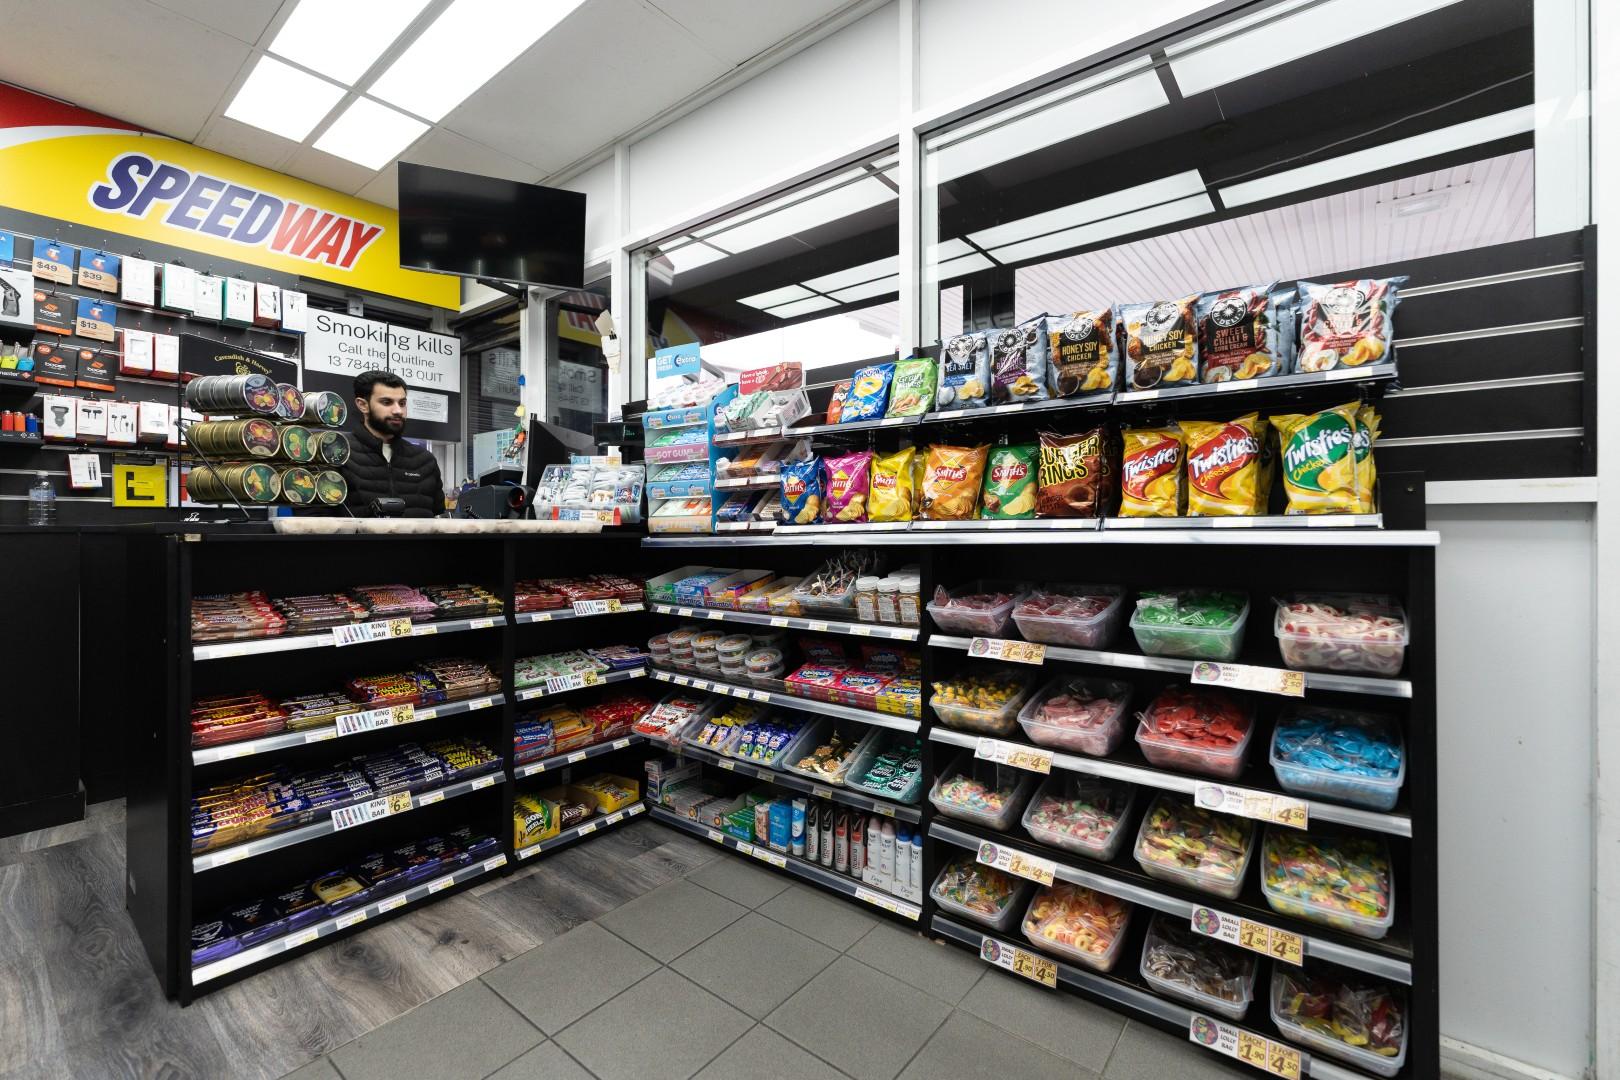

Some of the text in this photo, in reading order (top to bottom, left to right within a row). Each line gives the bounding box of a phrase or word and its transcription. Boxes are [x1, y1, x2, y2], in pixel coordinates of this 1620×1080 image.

[92, 154, 382, 269] SPEEDWAY
[36, 261, 58, 272] $49
[82, 270, 102, 281] $39
[80, 320, 97, 330] $13
[317, 315, 454, 356] Smoking kills
[1168, 329, 1184, 340] SOY
[1215, 326, 1245, 339] SWEET
[1149, 341, 1177, 352] CHICKEN
[1213, 333, 1240, 347] CHILLI
[338, 342, 435, 368] Call the Quitline
[1062, 341, 1098, 356] HONEY SOY
[214, 353, 245, 362] Cavendish
[657, 355, 696, 365] GET extra
[1067, 353, 1092, 362] CHICKEN
[328, 355, 342, 367] 13
[346, 357, 380, 373] 7848
[401, 367, 413, 378] 13
[416, 370, 444, 382] QUIT
[656, 450, 671, 459] GOT
[1284, 427, 1353, 472] Twisties
[1122, 446, 1179, 482] Twisties
[1189, 437, 1252, 479] Twisties
[1040, 457, 1089, 488] RINGS
[1200, 466, 1230, 487] Cheese
[371, 622, 387, 630] KING
[374, 709, 389, 717] KING
[375, 718, 389, 727] BAR
[370, 798, 386, 808] KING
[1221, 916, 1240, 926] SMALL
[1245, 923, 1264, 933] EACH
[1280, 933, 1296, 942] FOR
[1222, 924, 1300, 957] LOLLY $1.90 $4.50
[1001, 946, 1014, 954] SMALL
[1018, 952, 1031, 961] EACH
[1041, 961, 1052, 969] FOR
[1014, 959, 1033, 973] $1.90
[1035, 967, 1055, 982] $4.50
[1219, 1026, 1238, 1037] SMALL
[1244, 1035, 1262, 1046] EACH
[1278, 1047, 1293, 1057] FOR
[1221, 1043, 1234, 1051] BAG
[1220, 1034, 1298, 1073] LOLLY $1.90 $4.50
